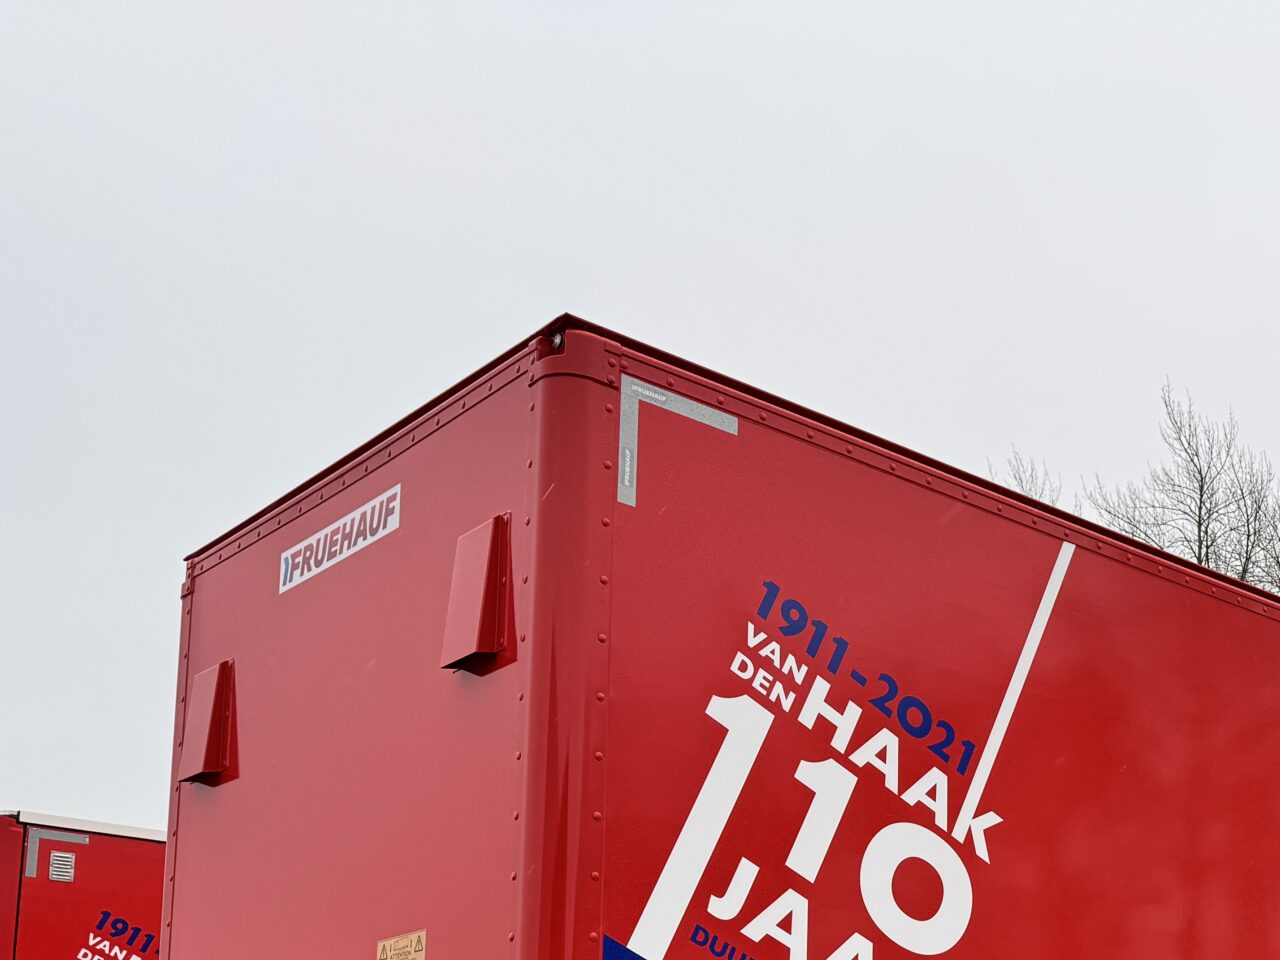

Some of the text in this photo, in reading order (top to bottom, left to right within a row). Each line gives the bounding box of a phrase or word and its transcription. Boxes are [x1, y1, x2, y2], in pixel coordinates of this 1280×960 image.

[287, 491, 398, 585] FRUEHAUF
[729, 651, 796, 713] DEN
[746, 620, 809, 686] VAN
[755, 580, 976, 776] 1911-2021
[797, 672, 1006, 864] HAAK
[88, 932, 128, 960] VAN
